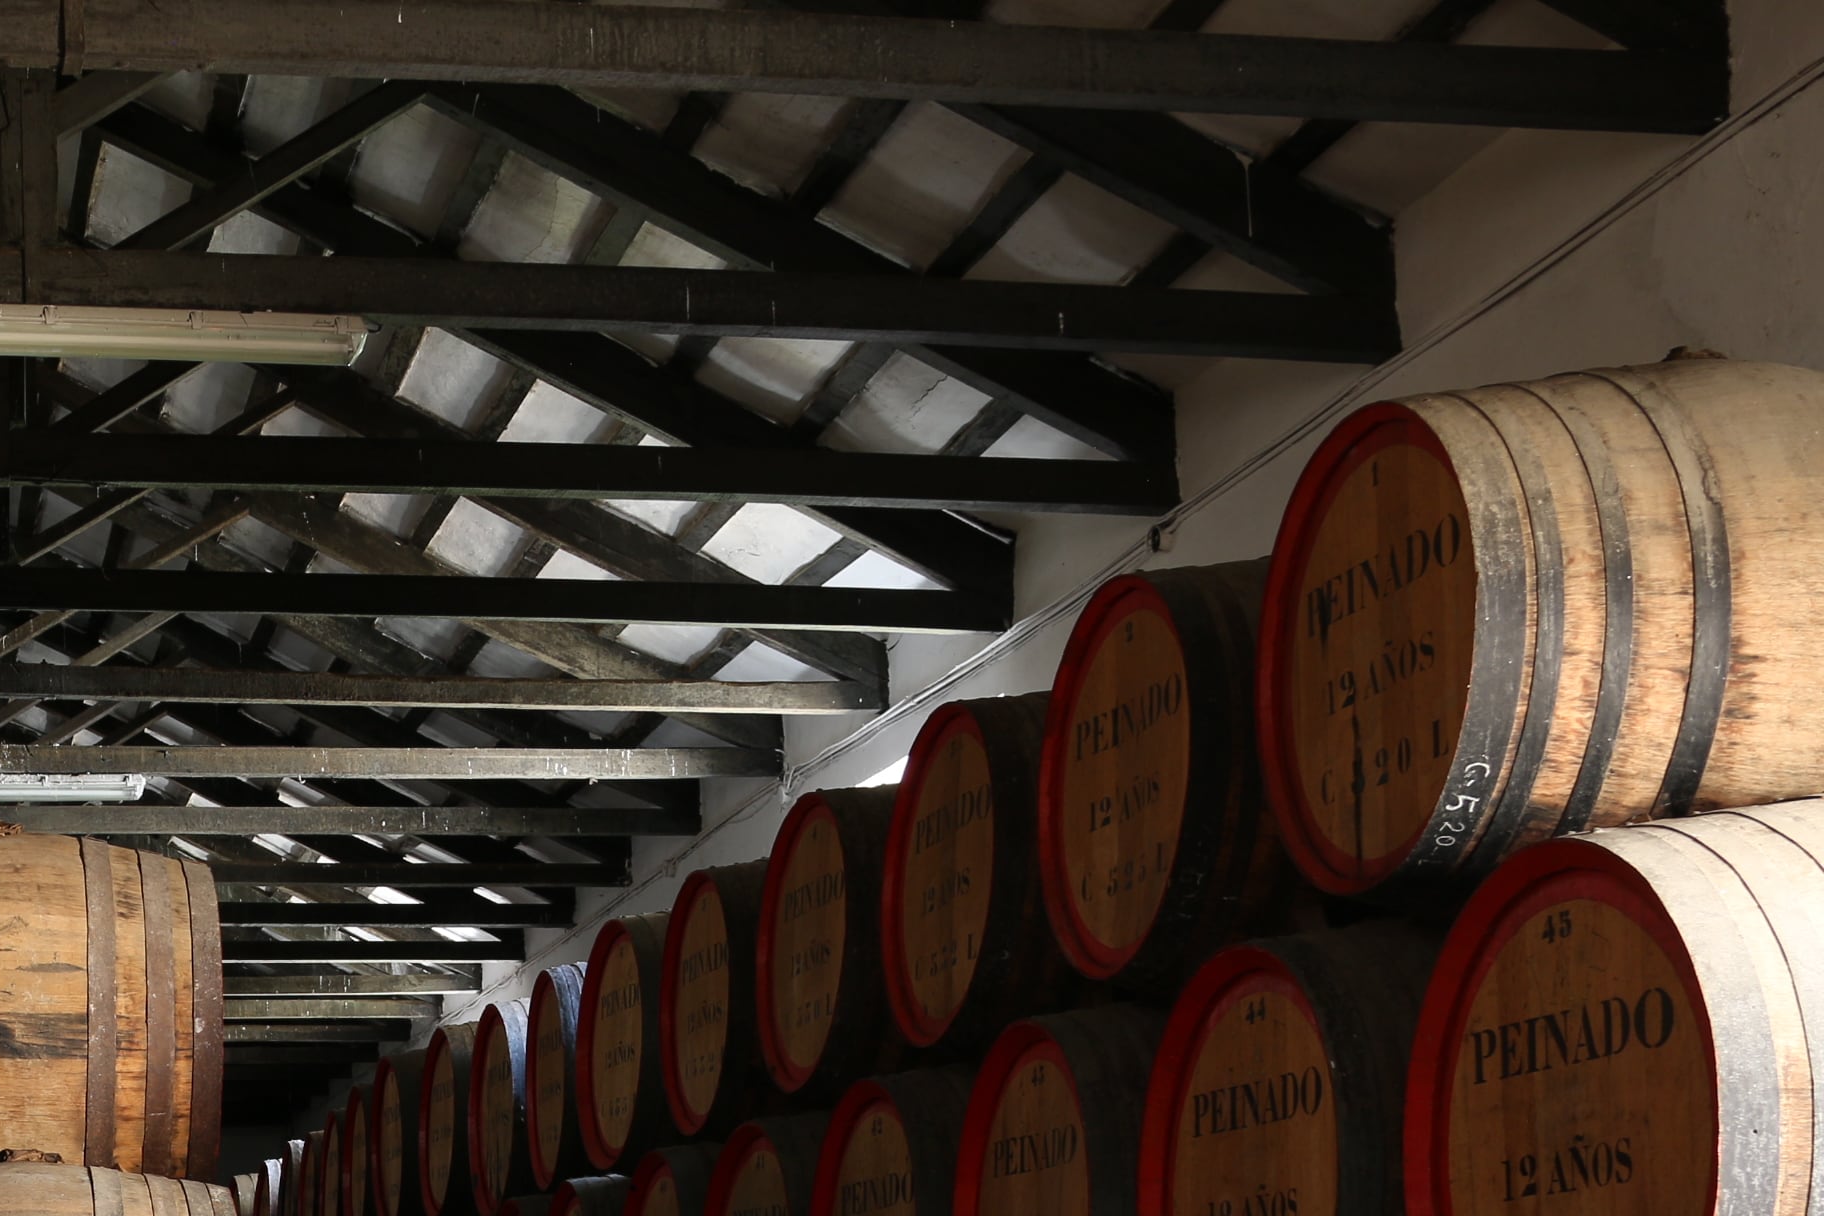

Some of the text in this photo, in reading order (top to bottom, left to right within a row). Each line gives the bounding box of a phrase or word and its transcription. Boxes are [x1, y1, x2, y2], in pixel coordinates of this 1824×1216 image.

[1307, 512, 1460, 640] PEINADO
[1327, 630, 1435, 716] 12 AÑOS
[1076, 673, 1182, 762] PEINADO
[1321, 769, 1336, 805] C
[1432, 719, 1450, 759] L
[916, 783, 990, 854] PEINADO
[1089, 770, 1161, 833] 12 AÑOS
[784, 871, 845, 923] PEINADO
[1542, 909, 1573, 946] 45
[1245, 997, 1266, 1025] 44
[1473, 987, 1675, 1085] PEINADO
[1193, 1065, 1323, 1138] PEINADO
[993, 1124, 1076, 1178] PEINADO
[1501, 1134, 1633, 1202] 12 AÑOS
[841, 1171, 914, 1216] PEINADO
